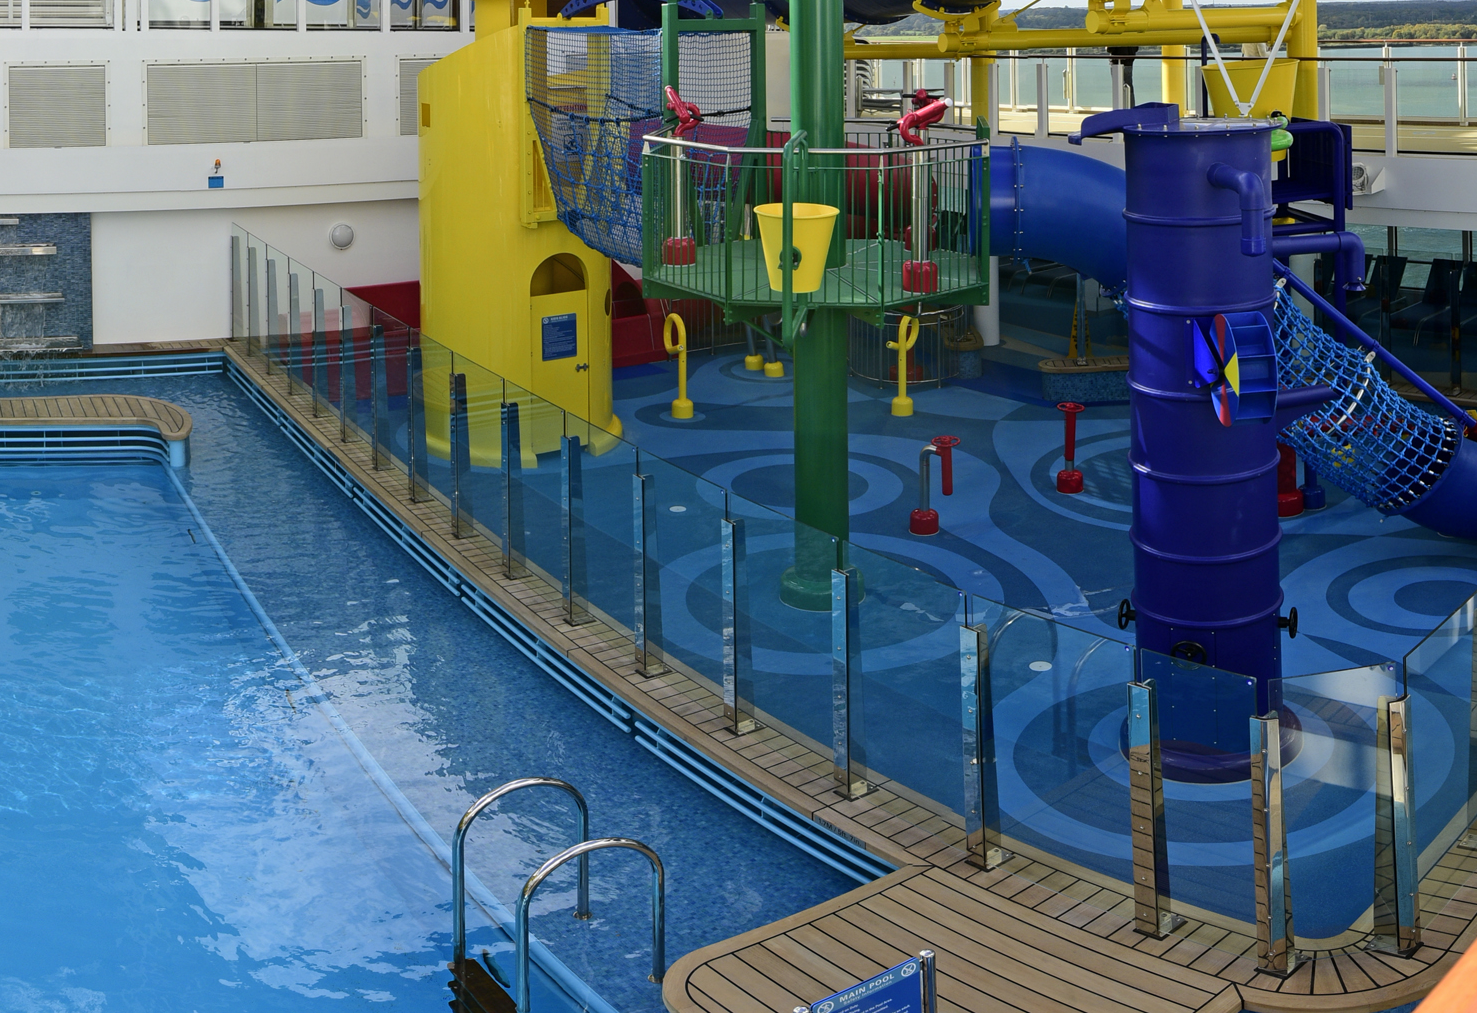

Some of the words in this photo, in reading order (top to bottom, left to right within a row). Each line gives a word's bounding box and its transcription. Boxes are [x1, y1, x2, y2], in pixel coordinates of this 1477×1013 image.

[839, 986, 865, 1003] MAIN
[869, 974, 895, 989] POOL
[843, 995, 861, 1005] Safety
[861, 981, 893, 997] Information
